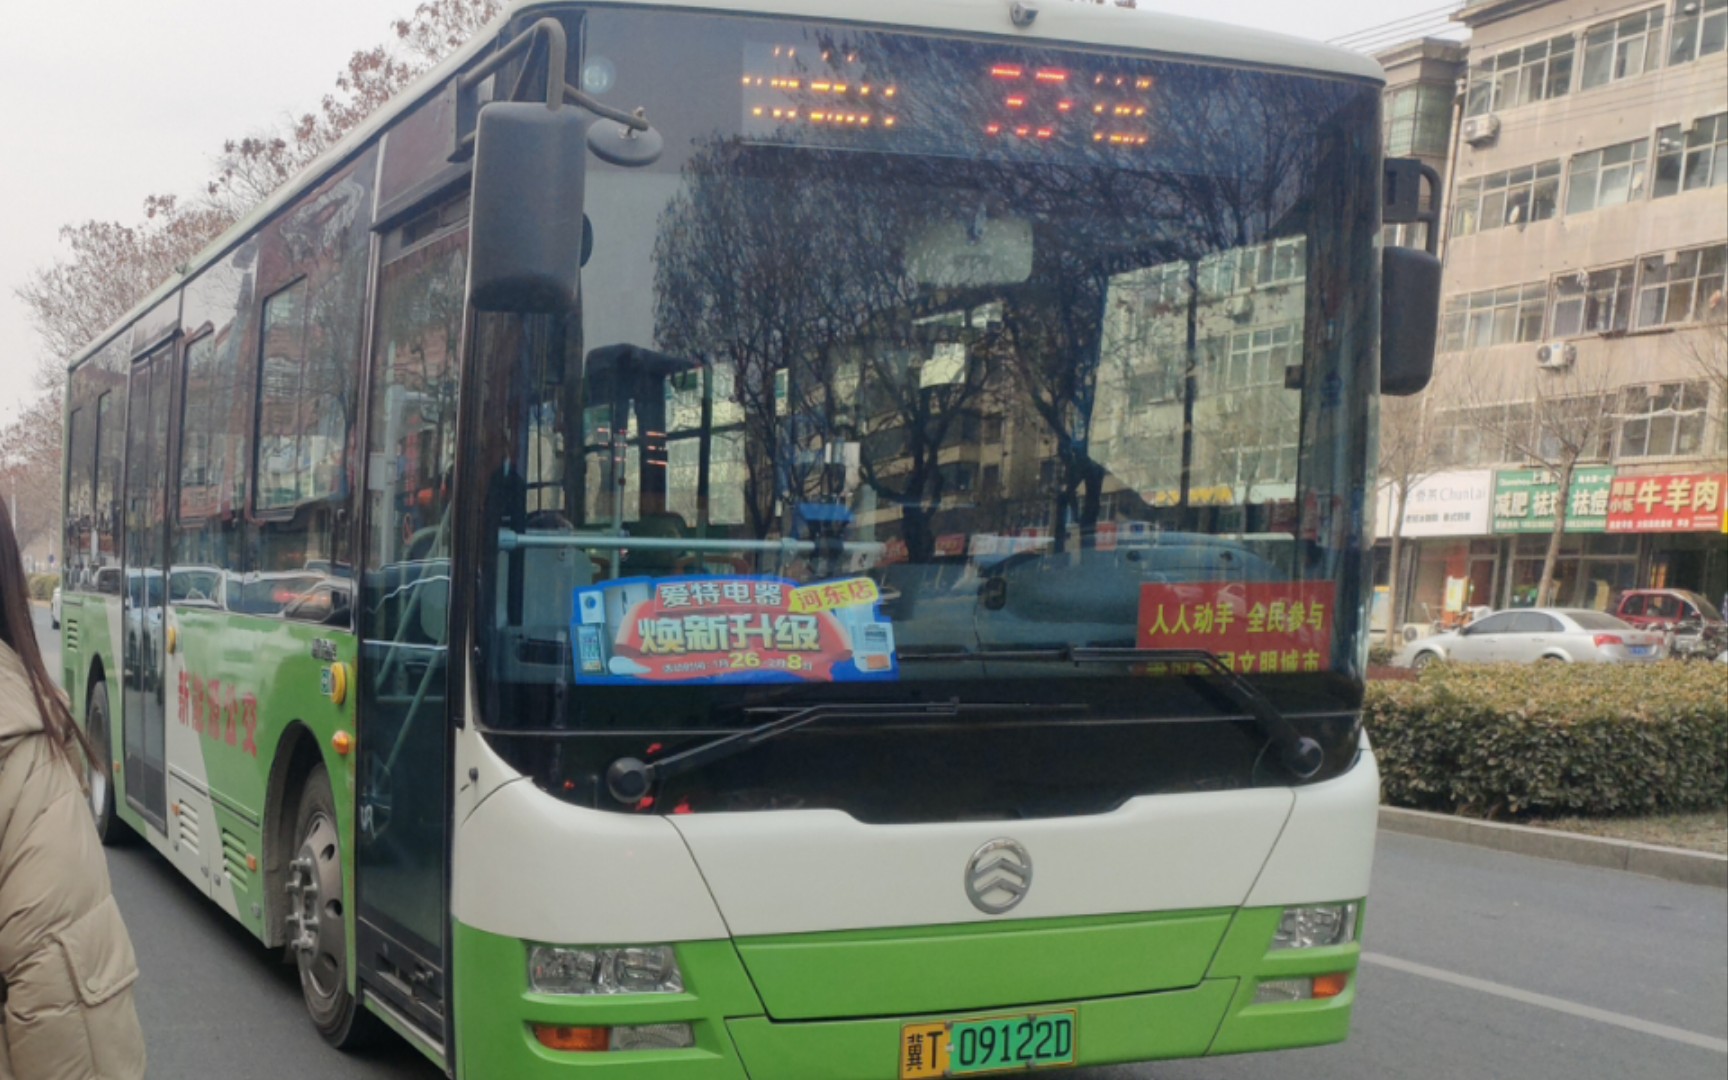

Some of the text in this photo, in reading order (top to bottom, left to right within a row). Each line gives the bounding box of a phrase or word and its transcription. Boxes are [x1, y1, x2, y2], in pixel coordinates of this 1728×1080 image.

[1495, 491, 1529, 517] 减肥
[1572, 487, 1609, 516] 祛痘
[1636, 478, 1718, 514] 牛羊肉
[660, 583, 783, 607] 爱特电器
[796, 580, 875, 608] 河东店
[637, 614, 820, 654] 焕新升级
[1150, 601, 1325, 634] 人人动手 全民参与
[906, 1019, 1073, 1072] 冀T 09122D
